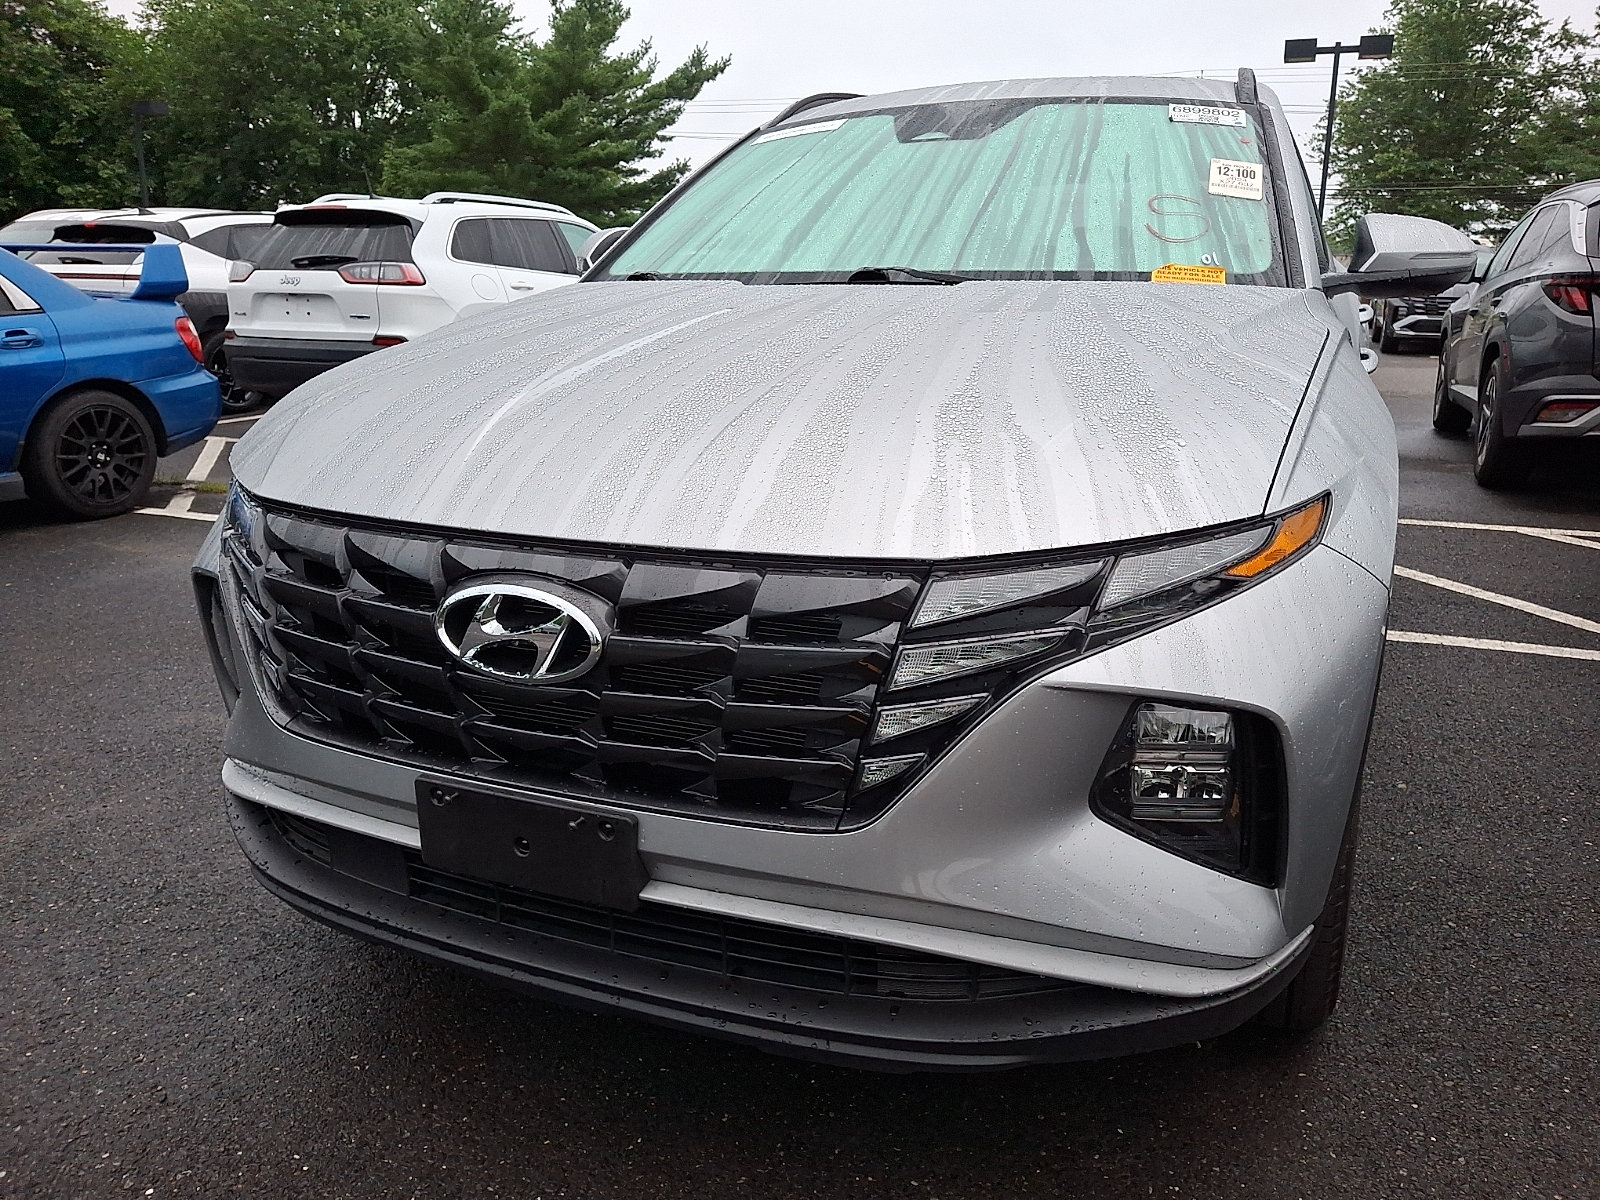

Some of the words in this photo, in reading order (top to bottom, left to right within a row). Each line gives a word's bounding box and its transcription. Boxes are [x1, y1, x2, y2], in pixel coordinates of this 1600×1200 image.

[1172, 106, 1239, 118] 6899802
[1216, 166, 1256, 180] 12:100
[279, 274, 301, 287] Jeep
